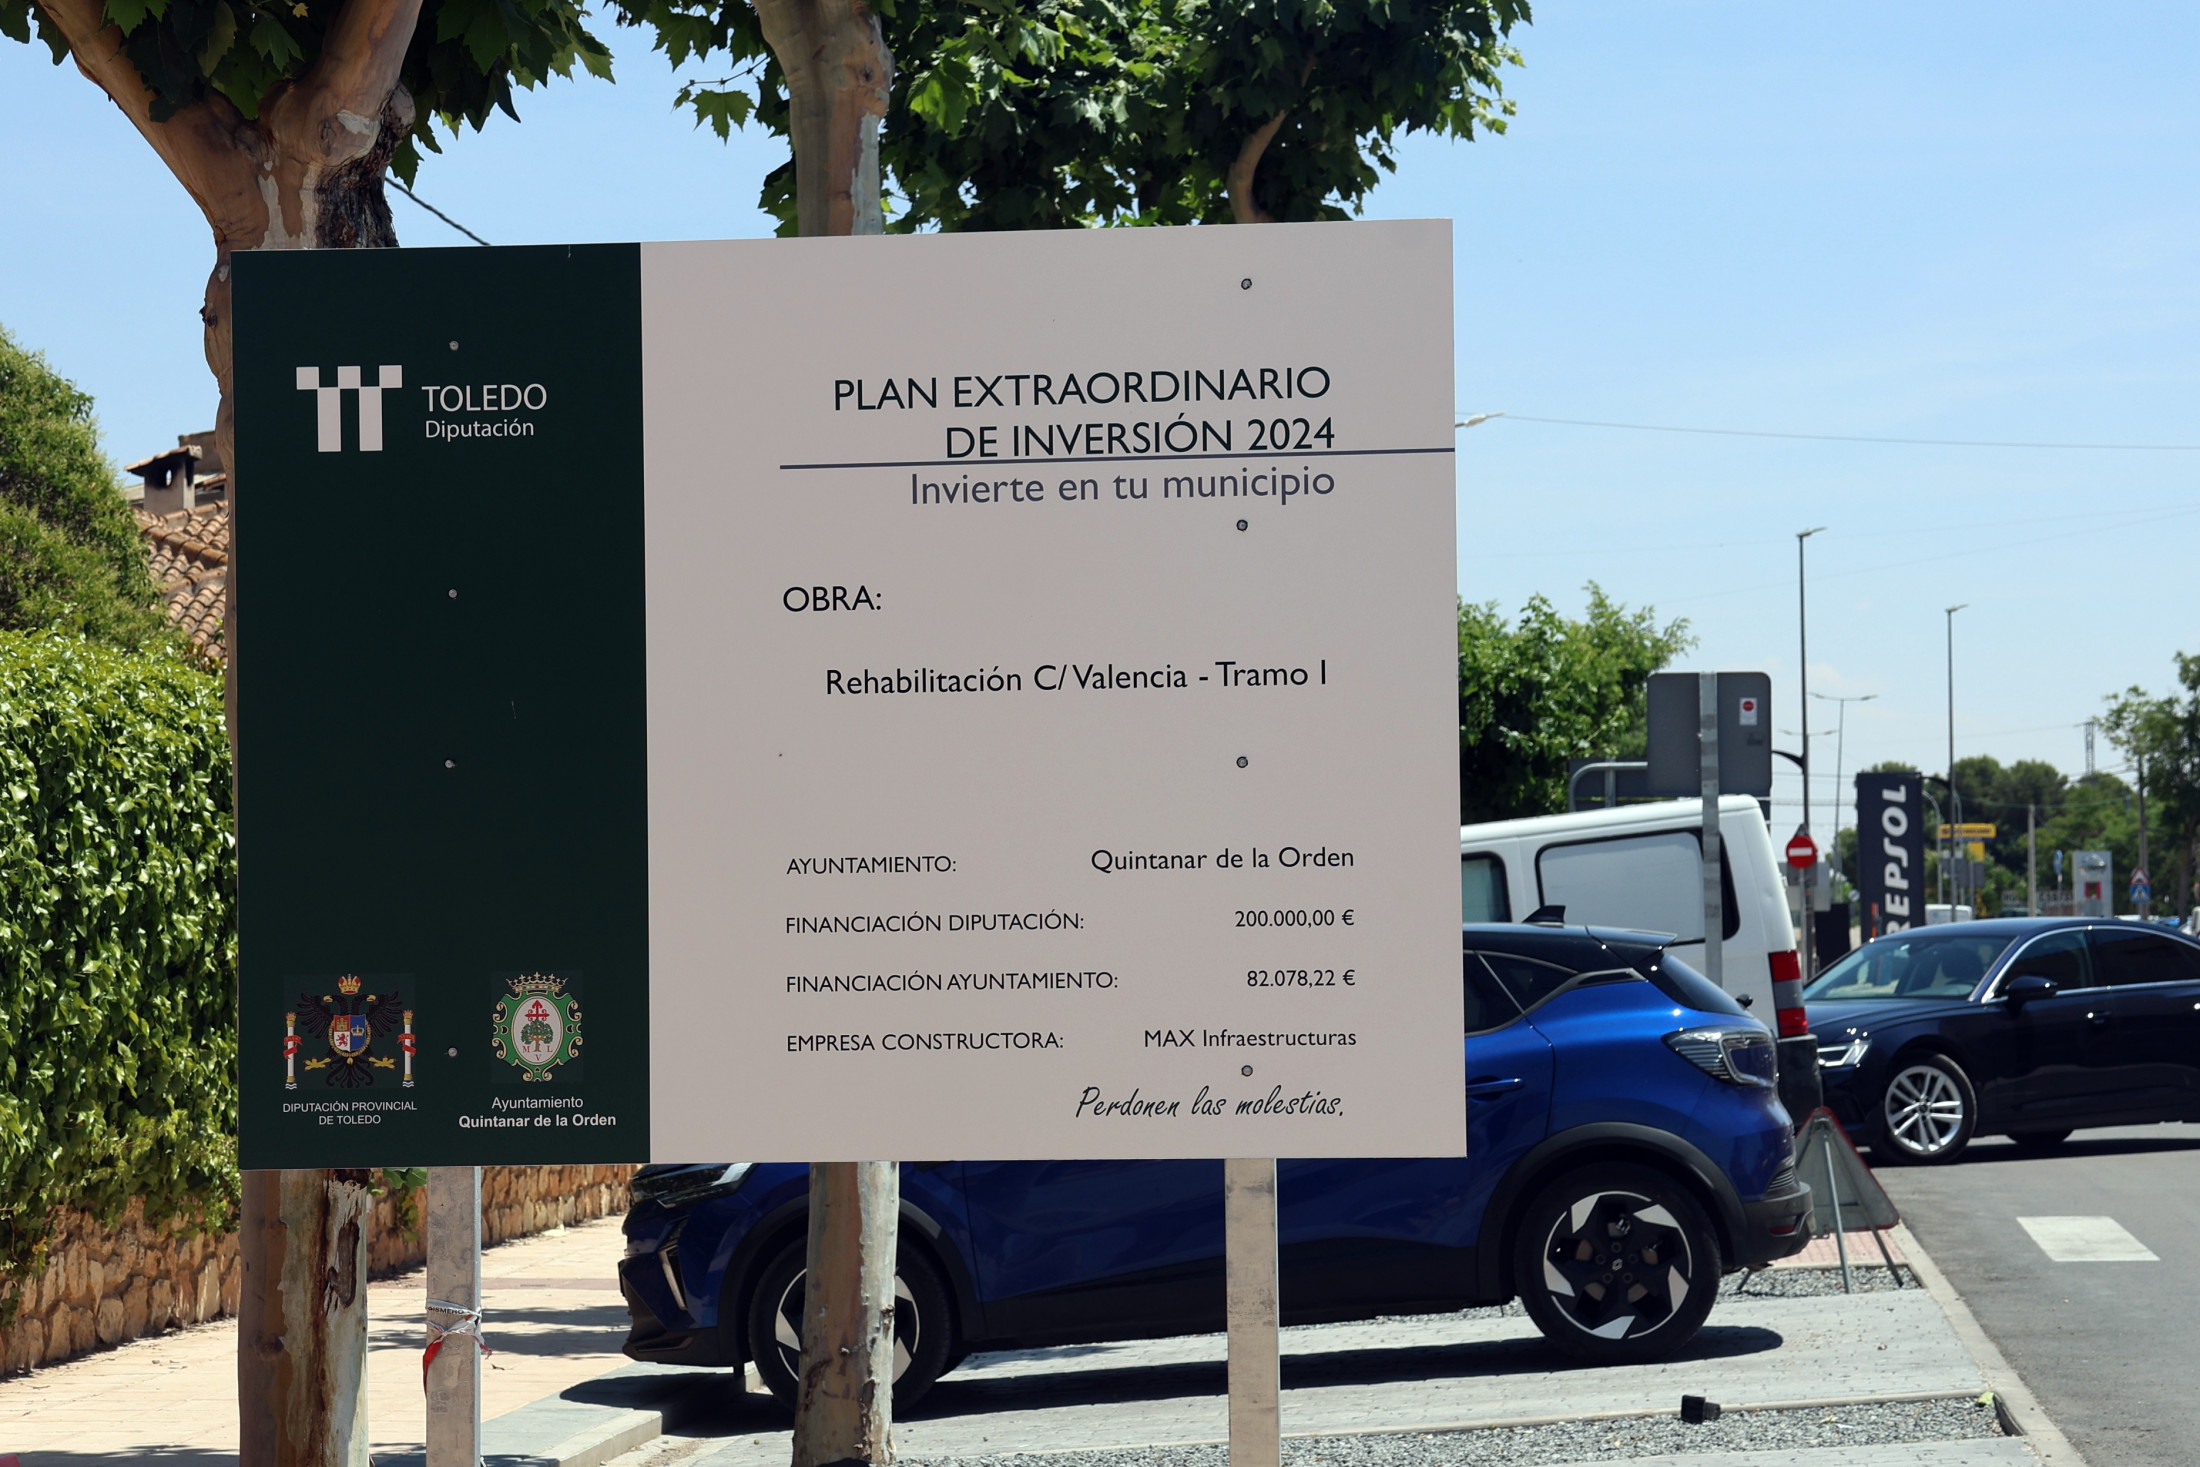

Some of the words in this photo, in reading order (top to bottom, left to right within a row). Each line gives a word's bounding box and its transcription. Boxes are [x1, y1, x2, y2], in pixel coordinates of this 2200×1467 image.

[421, 383, 547, 412] TOLEDO
[834, 376, 937, 412] PLAN
[953, 365, 1331, 408] EXTRAORDINARIO
[425, 417, 535, 442] Diputación
[946, 425, 999, 457] DE
[1013, 411, 1234, 457] INVERSIÓN
[1247, 416, 1336, 449] 2024
[911, 473, 1045, 505] Invierte
[1058, 478, 1099, 502] en
[1112, 474, 1148, 500] tu
[1163, 465, 1335, 506] municipio
[782, 584, 882, 613] OBRA:
[826, 665, 1022, 695] Rehabilitación
[1214, 660, 1309, 687] Tramo
[786, 855, 957, 875] AYUNTAMIENTO:
[1090, 849, 1208, 874] Quintanar
[1215, 847, 1244, 869] de
[1252, 847, 1271, 868] la
[1278, 846, 1354, 868] Orden
[786, 910, 942, 934] FINANCIACIÓN
[948, 908, 1084, 932] DIPUTACIÓN:
[1234, 909, 1335, 929] 200.000,00
[1341, 908, 1355, 927] €
[786, 969, 942, 993] FINANCIACIÓN
[946, 971, 1119, 991] AYUNTAMIENTO:
[1246, 969, 1336, 989] 82.078,22
[1342, 968, 1356, 987] €
[522, 1045, 531, 1053] M
[787, 1033, 876, 1052] EMPRESA
[881, 1031, 1064, 1051] CONSTRUCTORA:
[1144, 1029, 1196, 1048] MAX
[1203, 1028, 1357, 1047] Infraestructuras
[282, 1100, 349, 1113] DIPUTACIÓN
[351, 1100, 418, 1113] PROVINCIAL
[491, 1095, 584, 1113] Ayuntamiento
[1075, 1085, 1181, 1119] Perdonen
[1190, 1084, 1227, 1116] las
[1234, 1084, 1344, 1117] molestias.
[318, 1115, 335, 1126] DE
[336, 1114, 382, 1125] TOLEDO
[458, 1114, 531, 1129] Quintanar
[533, 1114, 552, 1127] de
[555, 1113, 569, 1127] la
[572, 1113, 617, 1127] Orden
